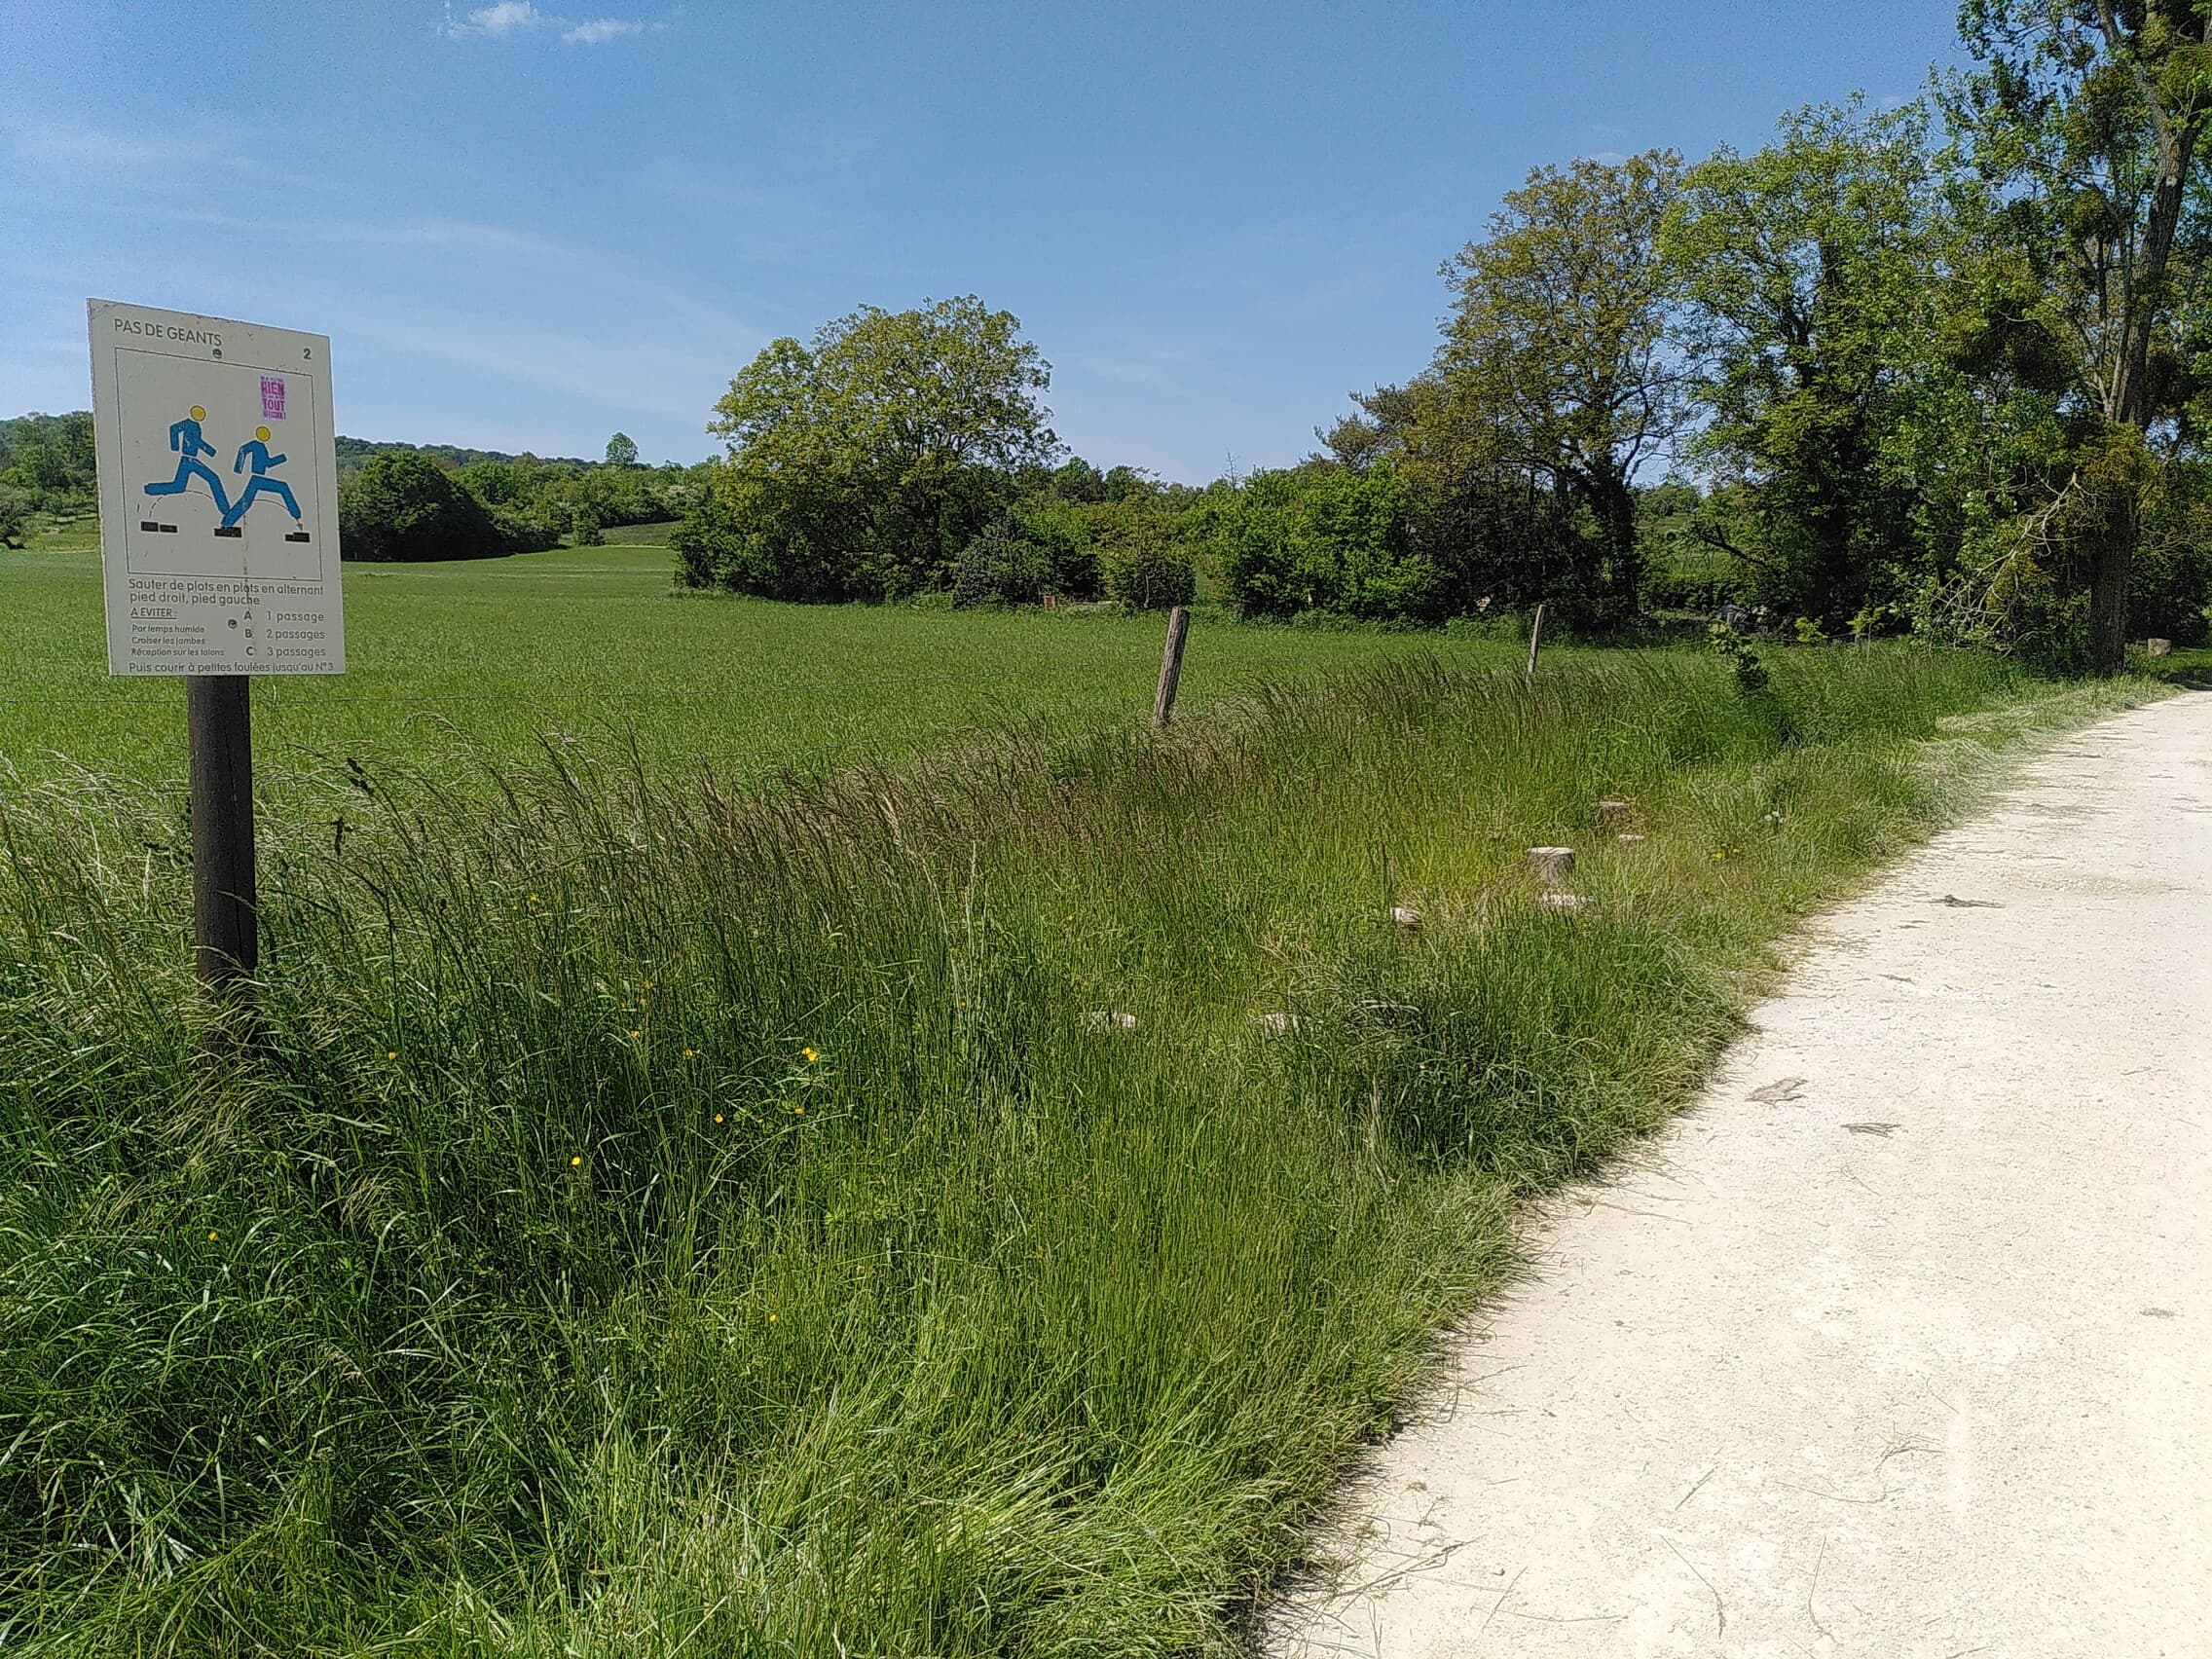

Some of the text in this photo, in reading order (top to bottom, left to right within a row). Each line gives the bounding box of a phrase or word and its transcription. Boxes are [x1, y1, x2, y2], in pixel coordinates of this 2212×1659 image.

[114, 318, 222, 347] PAS DE GEANTS
[304, 348, 312, 360] 2
[129, 578, 323, 595] Sauter de plots en plots en alternant
[129, 592, 260, 607] pied droit, pied gauche
[129, 608, 138, 616] A
[140, 608, 172, 616] EVITER
[243, 610, 252, 620] A
[276, 612, 324, 623] passage
[131, 624, 204, 634] Par temps humide
[244, 628, 325, 642] B 2 passages
[175, 637, 205, 645] jambes
[131, 647, 172, 657] Réception
[245, 646, 326, 658] C 3 passages
[129, 662, 152, 673] Puis
[155, 663, 185, 673] courir
[188, 663, 195, 672] à
[198, 663, 232, 674] petites
[234, 662, 271, 672] foulées
[273, 662, 313, 673] jusqu'au
